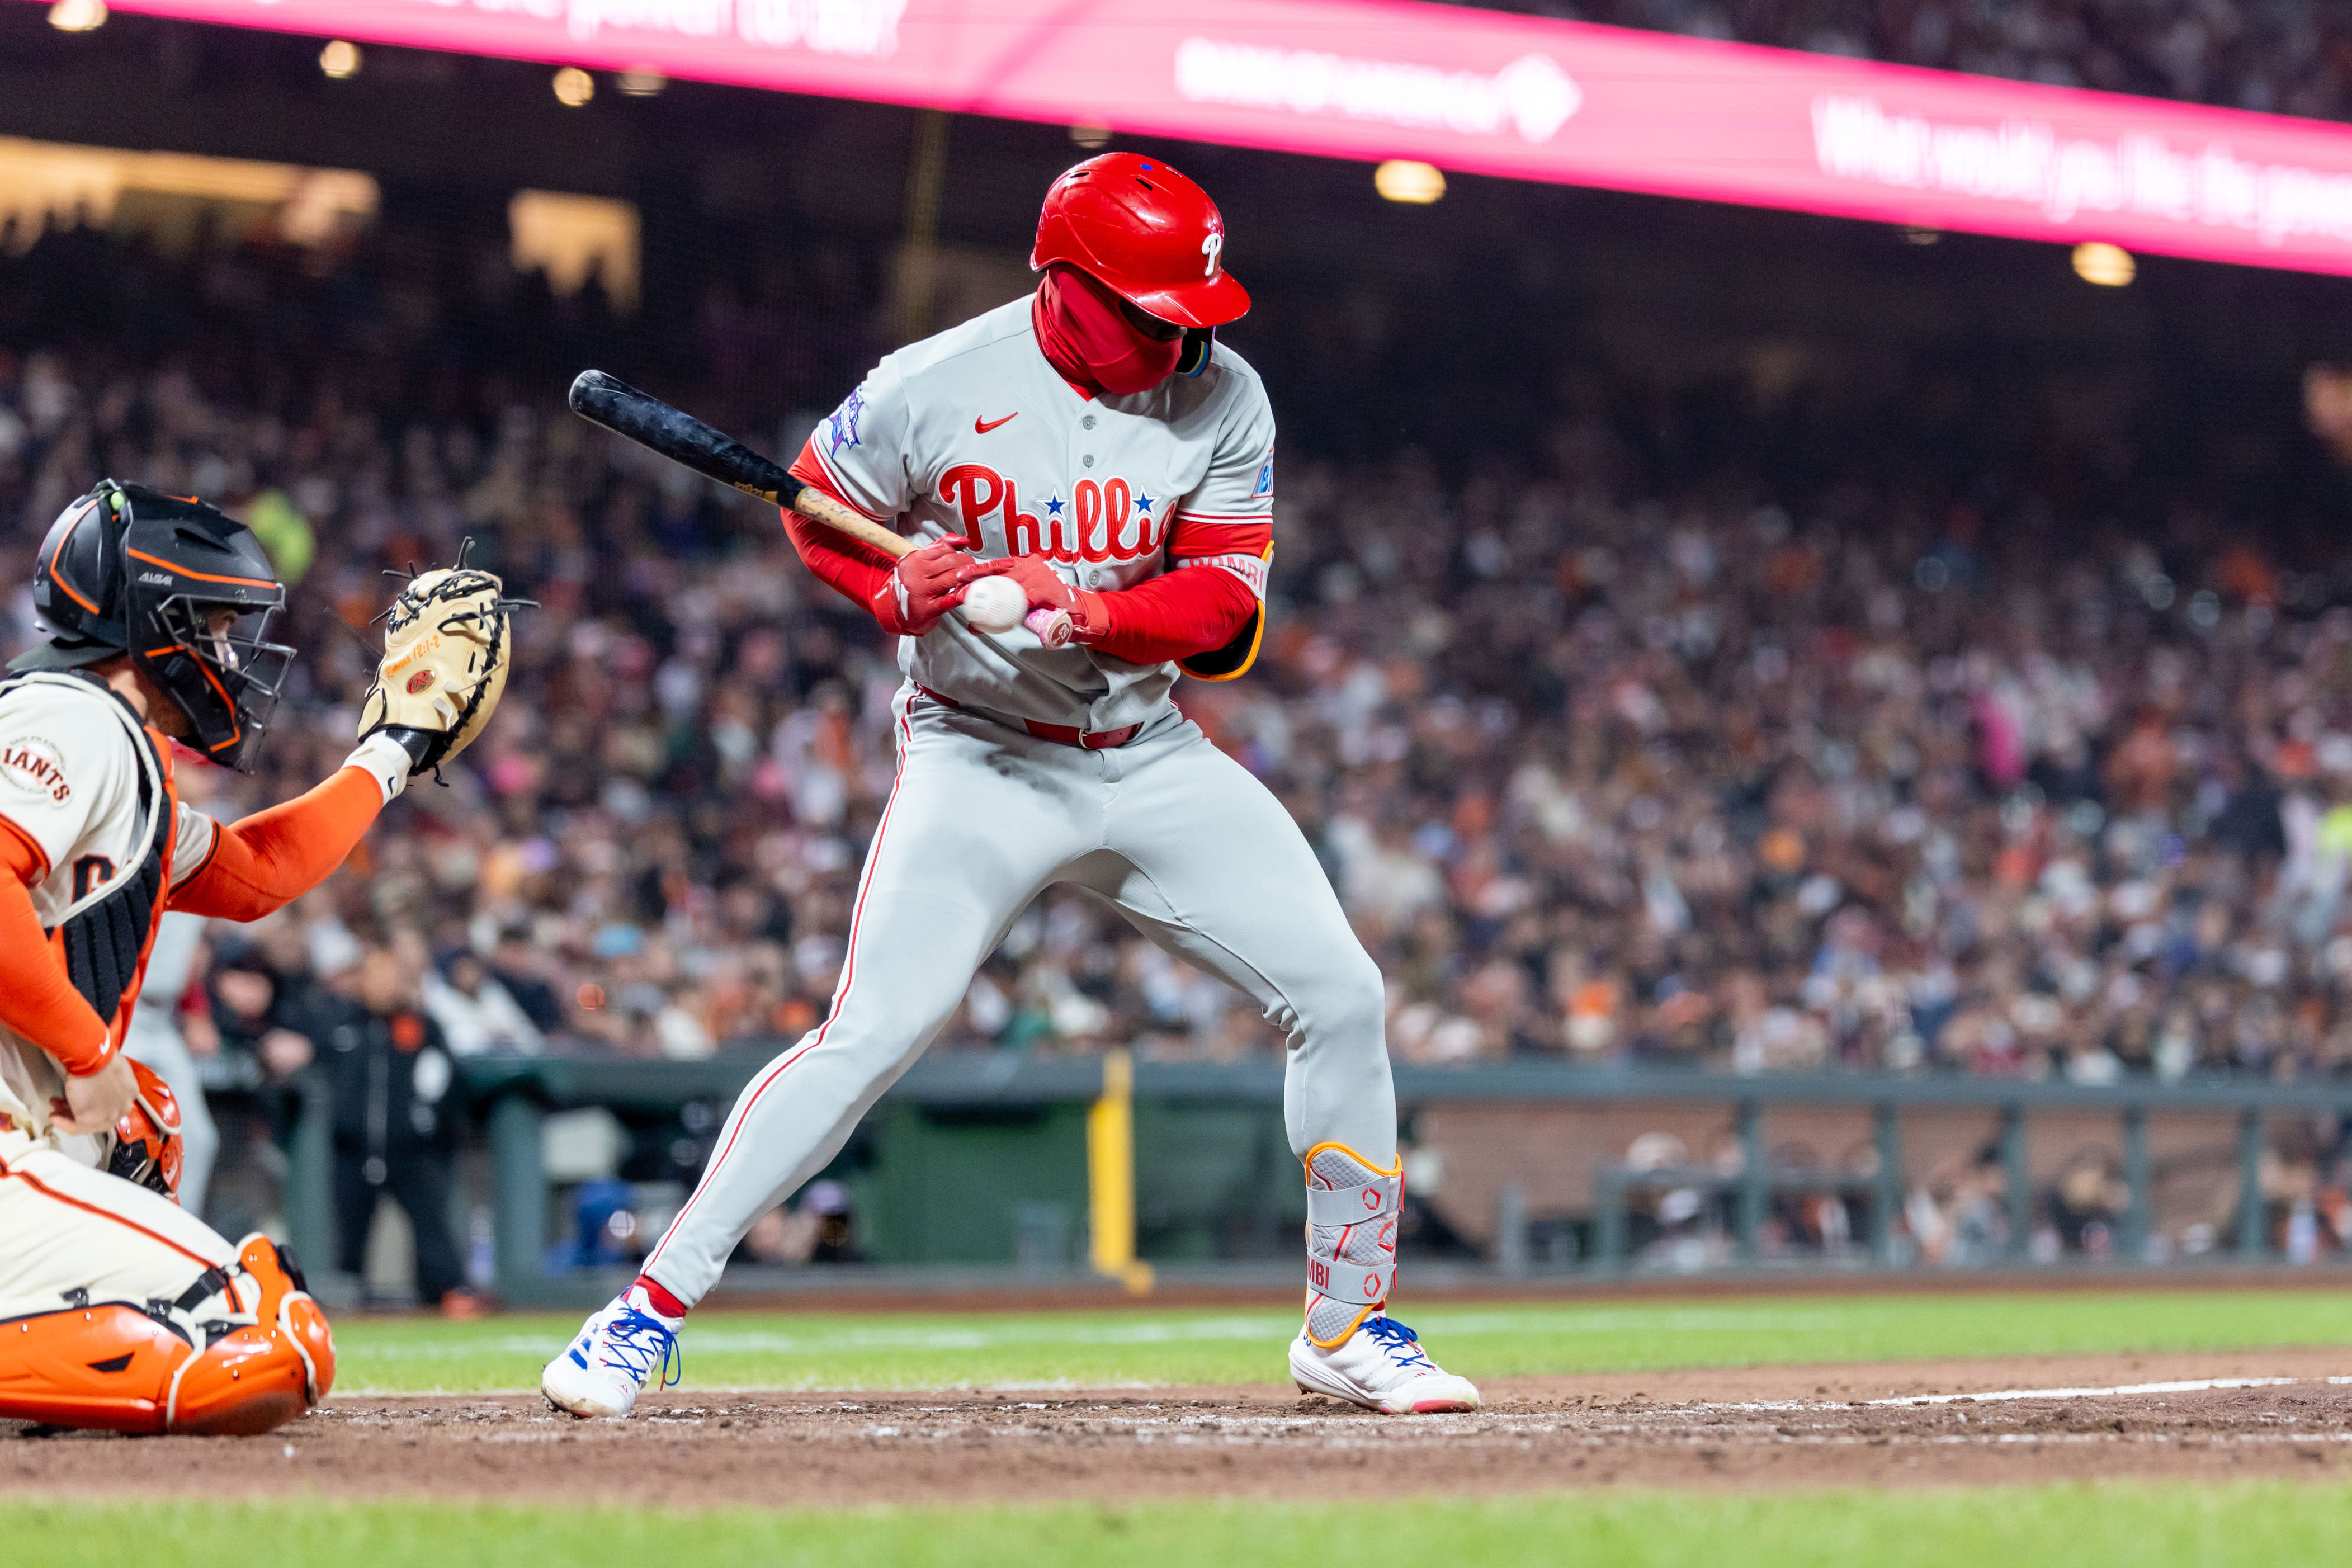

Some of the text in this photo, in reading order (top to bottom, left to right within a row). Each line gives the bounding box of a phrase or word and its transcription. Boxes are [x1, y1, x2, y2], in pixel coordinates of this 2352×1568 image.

[1201, 233, 1222, 276] P
[413, 634, 440, 660] 12:1-2
[1, 748, 70, 801] IANTS
[1307, 1255, 1329, 1290] MBI
